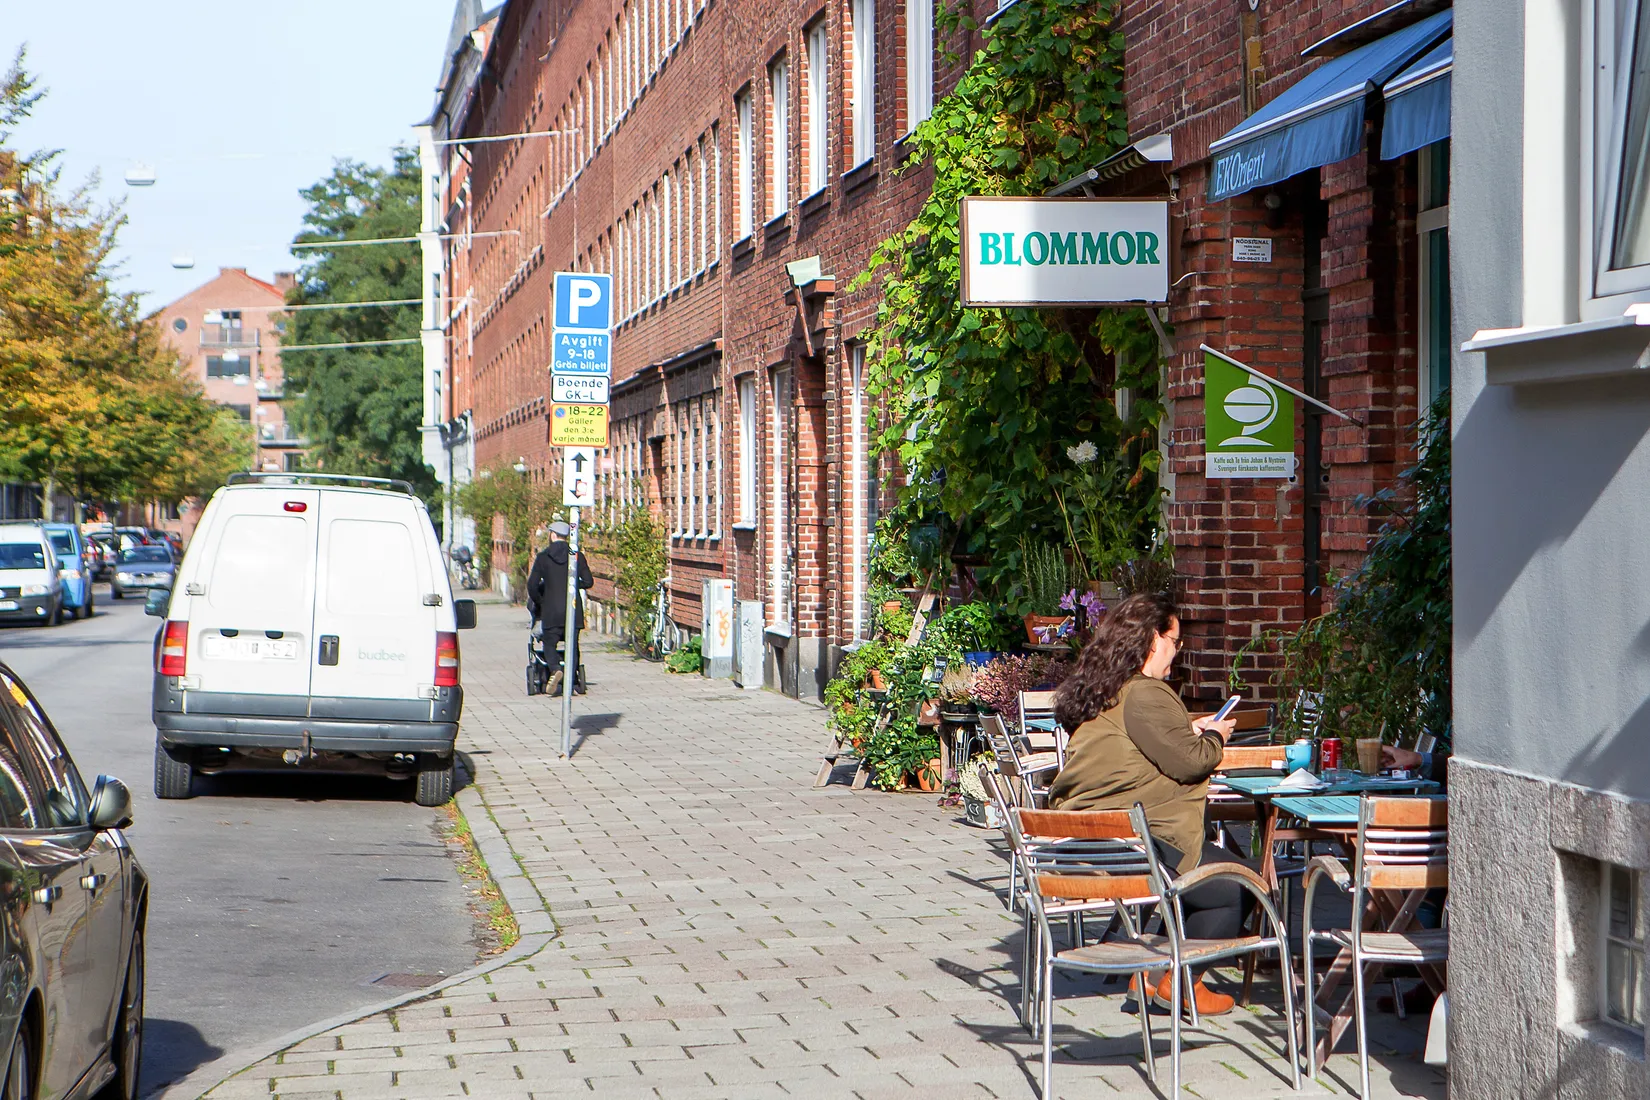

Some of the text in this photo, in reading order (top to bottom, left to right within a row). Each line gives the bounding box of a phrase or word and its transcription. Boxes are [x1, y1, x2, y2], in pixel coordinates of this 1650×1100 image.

[979, 230, 1160, 266] BLOMMOR
[569, 278, 602, 325] P
[560, 334, 603, 348] Avgift
[567, 348, 596, 360] 9-18
[555, 360, 607, 371] Grön biljett
[558, 377, 603, 388] Boende
[565, 389, 595, 401] GK-L
[569, 405, 604, 416] 18-22
[568, 417, 594, 425] Gäller
[582, 426, 595, 434] 3:e
[553, 434, 605, 443] varje månad
[1213, 456, 1226, 464] Kaffe
[1226, 456, 1235, 464] och
[1250, 456, 1263, 464] Johan
[1268, 456, 1287, 465] Nyström
[1217, 464, 1237, 473] Sveriges
[358, 646, 406, 662] budbee
